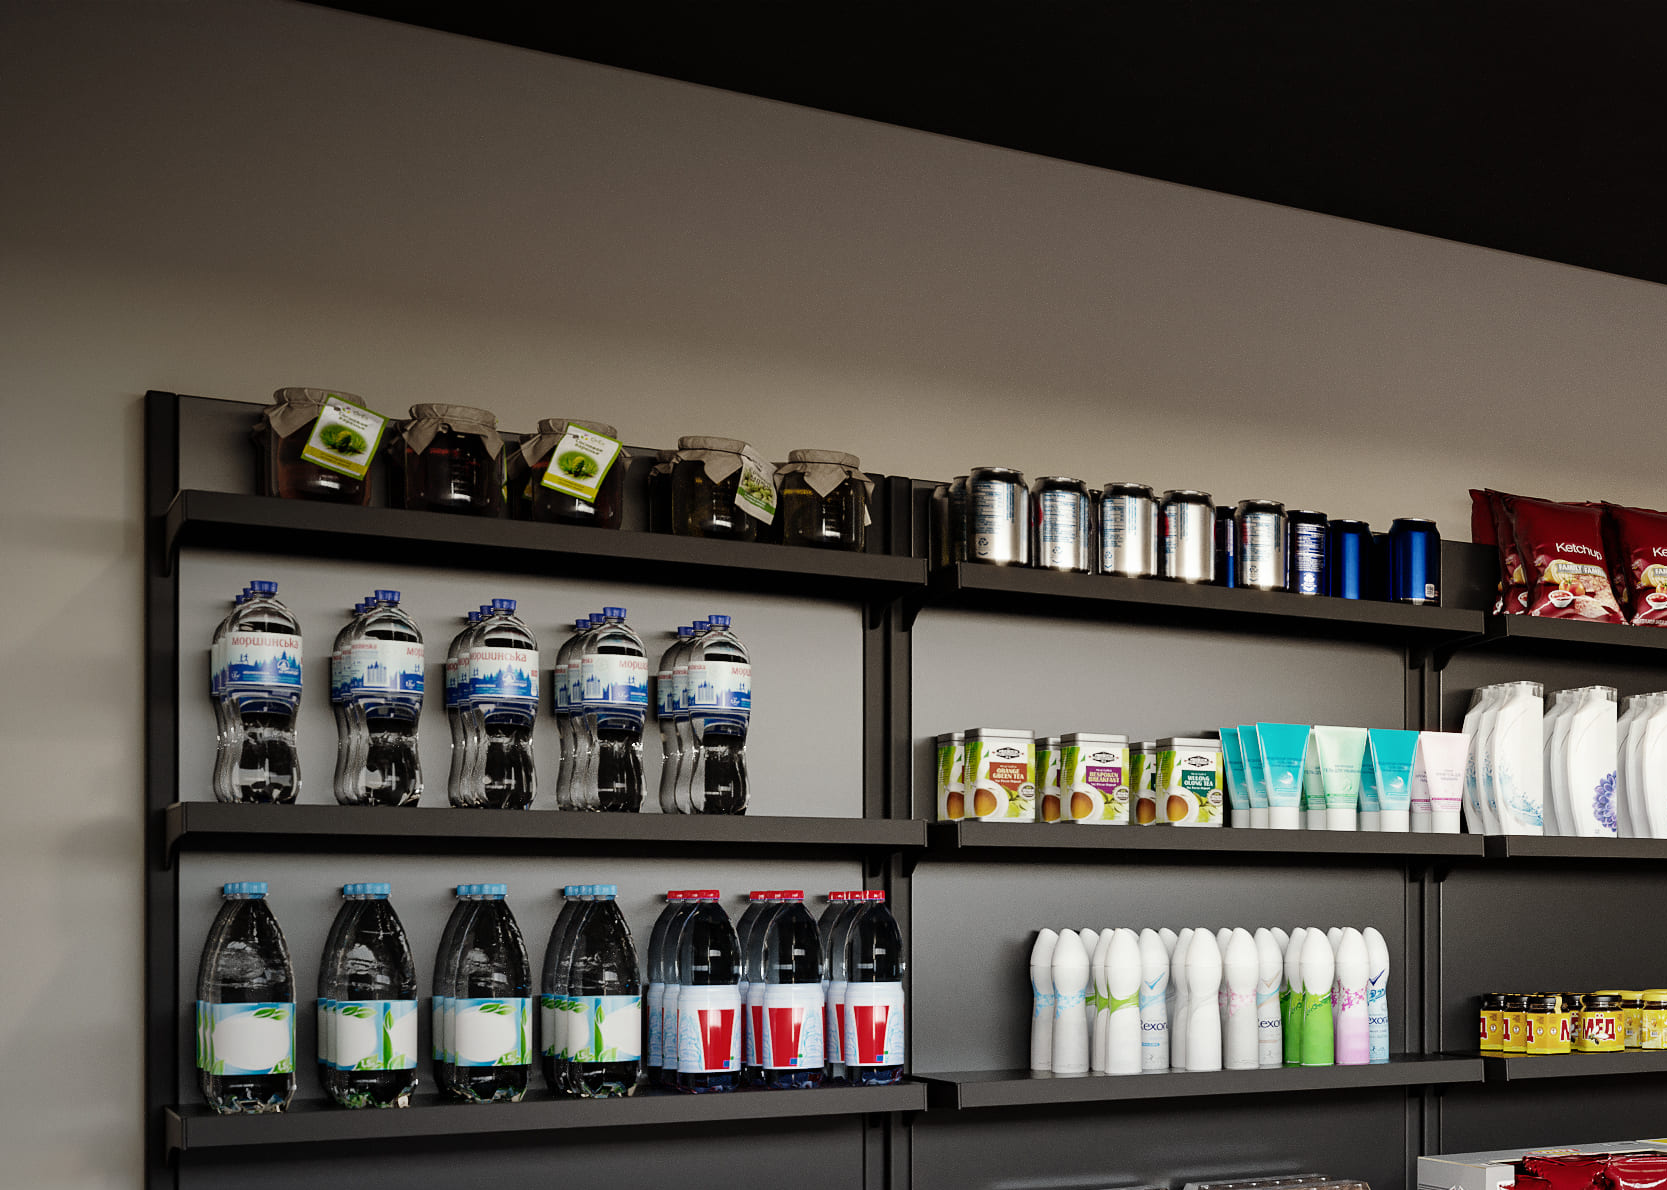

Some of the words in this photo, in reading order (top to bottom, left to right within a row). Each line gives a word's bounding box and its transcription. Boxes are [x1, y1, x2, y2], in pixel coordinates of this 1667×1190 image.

[1555, 542, 1603, 561] Ketchup
[232, 635, 299, 650] моршинська
[1140, 1019, 1169, 1031] exon
[1582, 1012, 1616, 1041] МЁД
